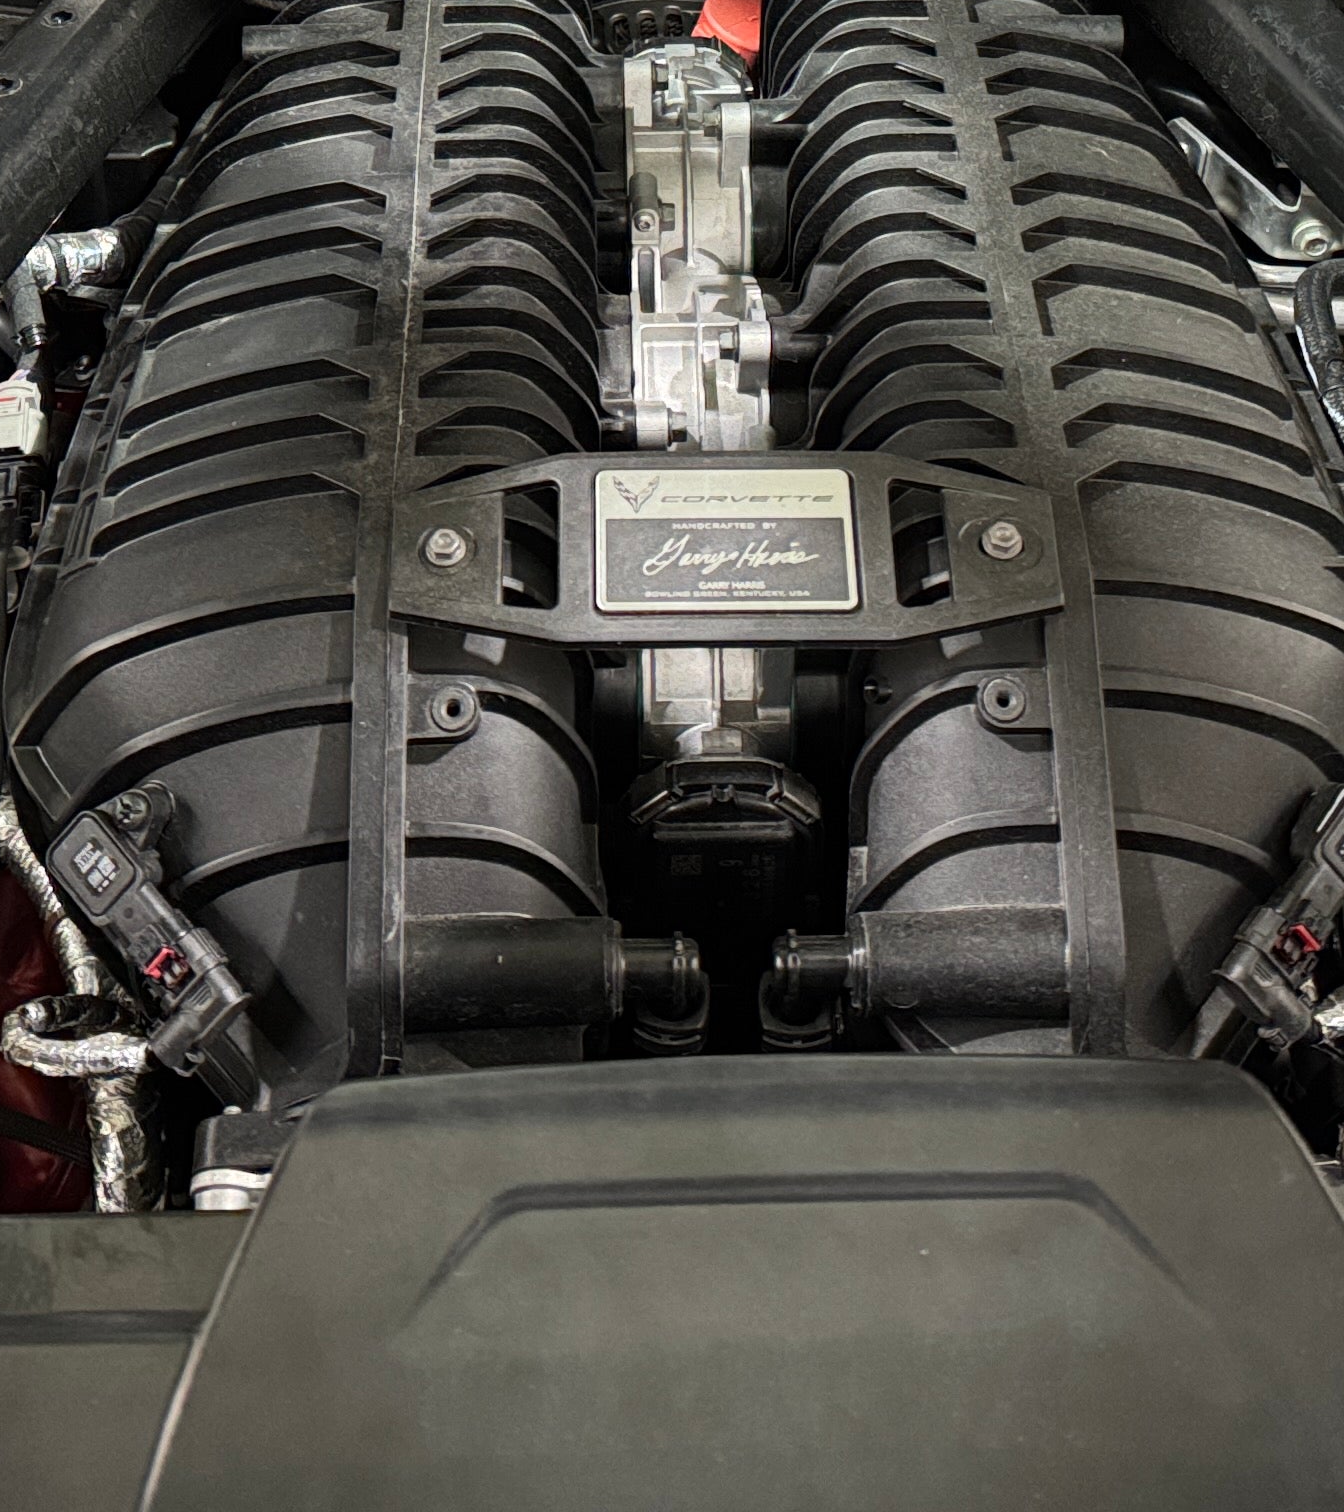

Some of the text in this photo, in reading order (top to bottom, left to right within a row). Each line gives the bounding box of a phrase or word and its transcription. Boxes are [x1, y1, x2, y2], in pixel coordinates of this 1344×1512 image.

[660, 494, 834, 503] CORVETTE
[672, 522, 778, 530] HANDCRAFTED BY
[788, 590, 810, 598] USA
